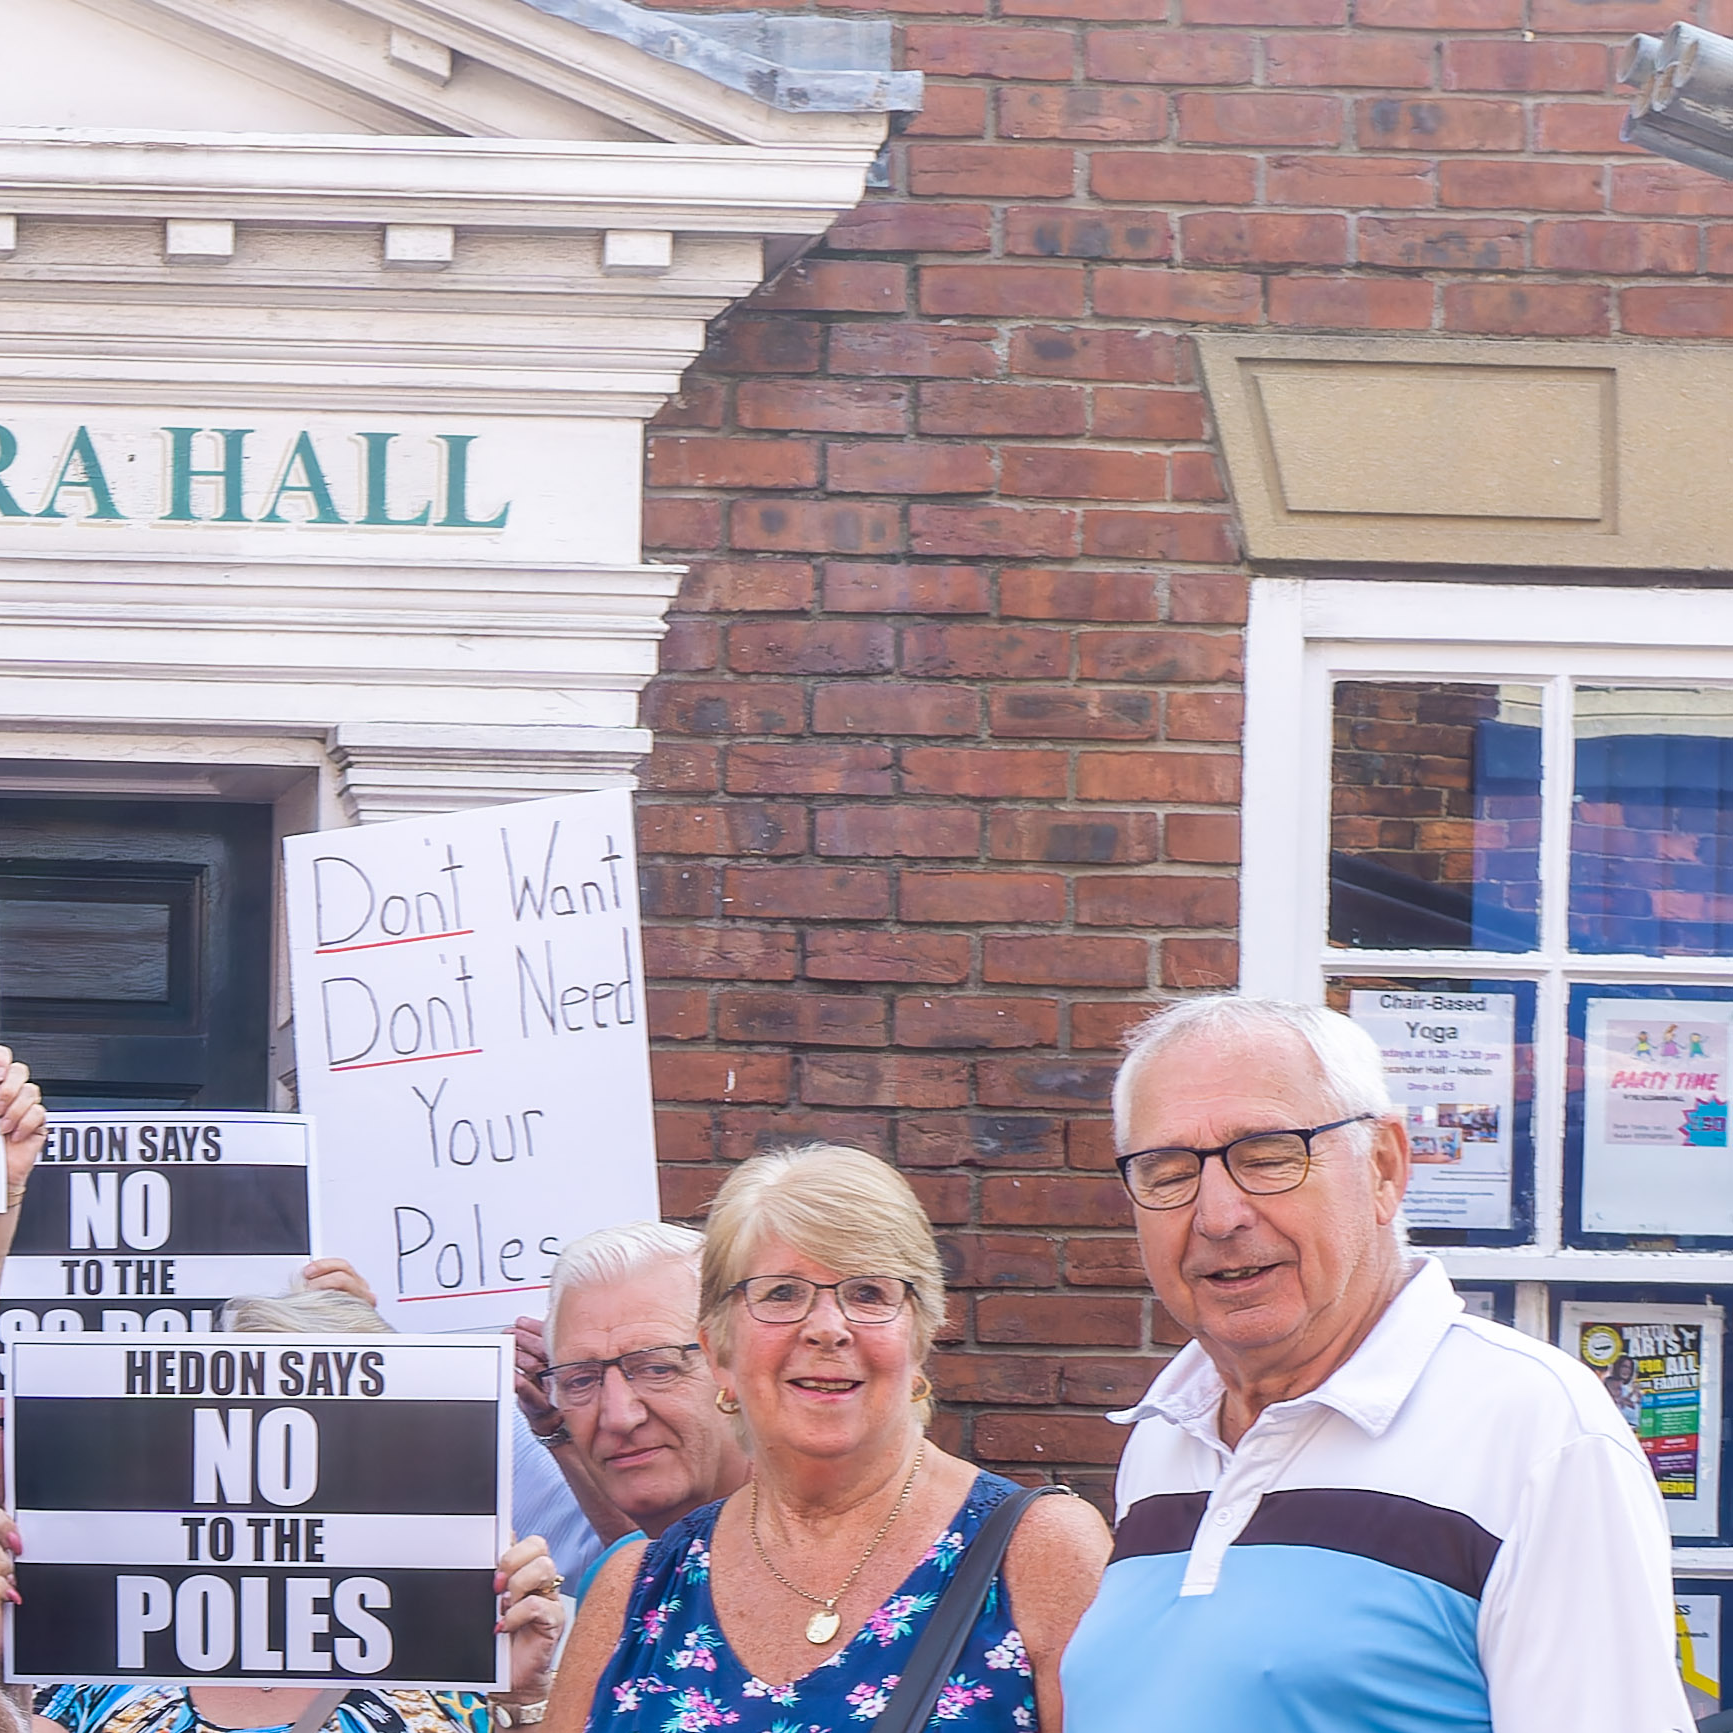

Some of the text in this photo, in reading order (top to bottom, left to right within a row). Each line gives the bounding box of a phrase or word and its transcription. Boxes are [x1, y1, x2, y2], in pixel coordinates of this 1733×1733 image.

[159, 426, 511, 529] HALL
[500, 820, 623, 921] Want
[515, 927, 634, 1039] Need
[1380, 994, 1487, 1012] Chair-Based
[1405, 1021, 1459, 1043] Yoga
[1611, 1071, 1720, 1091] PARTY TIME
[41, 1126, 222, 1162] EDON SAYS
[411, 1077, 543, 1168] Your
[69, 1170, 171, 1250] NO
[61, 1260, 176, 1295] TO THE
[394, 1204, 560, 1294] Poles
[125, 1350, 386, 1397] HEDON SAYS
[1665, 1355, 1698, 1375] ALL
[192, 1406, 320, 1507] NO
[181, 1516, 325, 1564] TO THE
[115, 1574, 393, 1674] POLES
